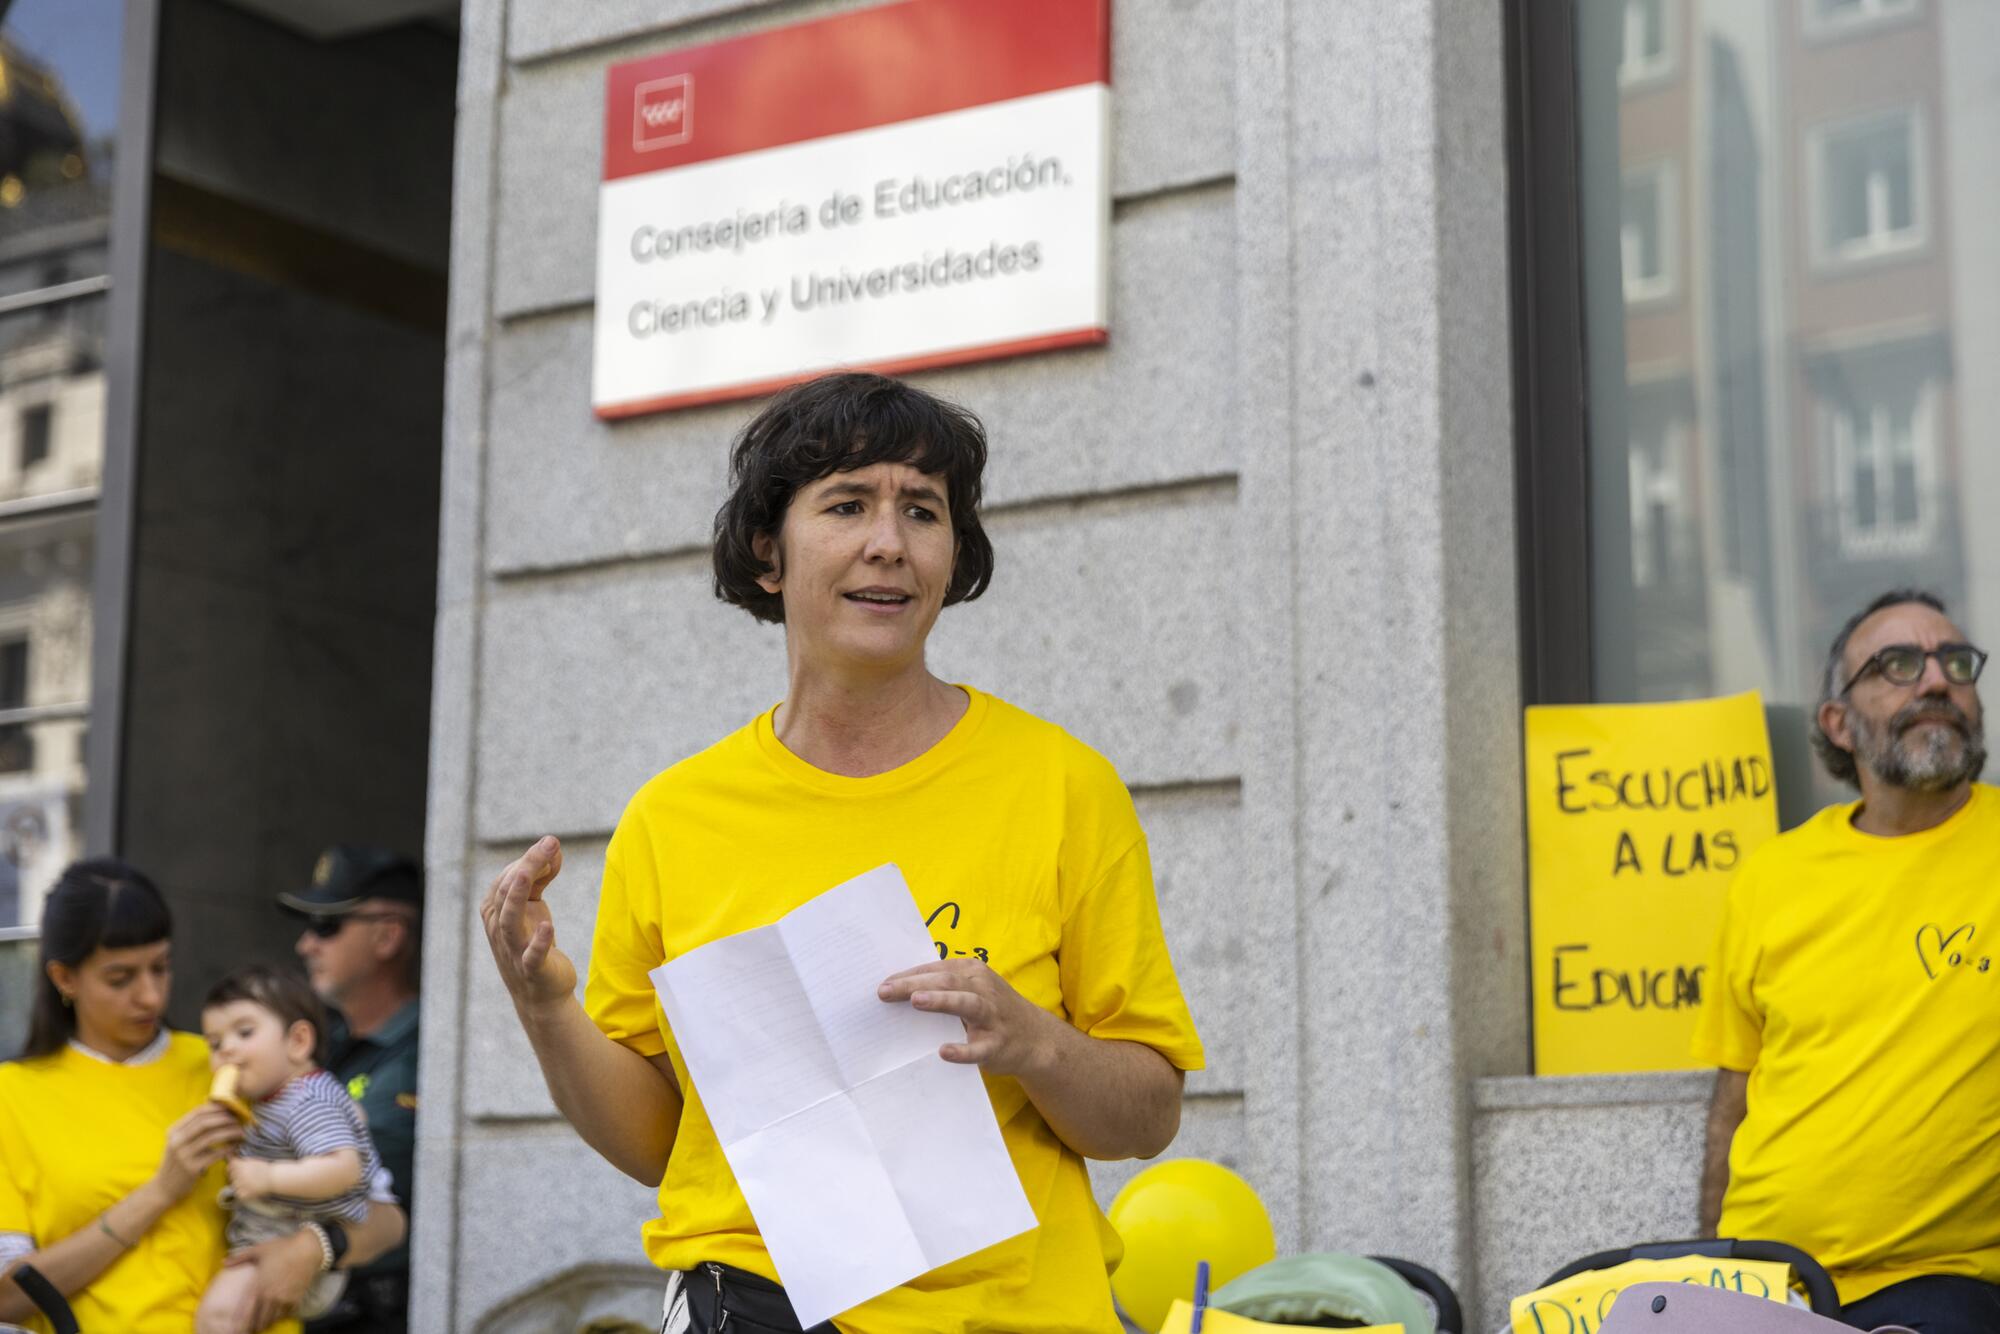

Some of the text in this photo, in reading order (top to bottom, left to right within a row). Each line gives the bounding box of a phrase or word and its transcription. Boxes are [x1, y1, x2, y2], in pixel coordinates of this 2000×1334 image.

[630, 199, 808, 265] Consejería
[819, 187, 863, 230] de
[628, 239, 1043, 339] Ciencia y Universidades
[1612, 830, 1739, 877] A LAS
